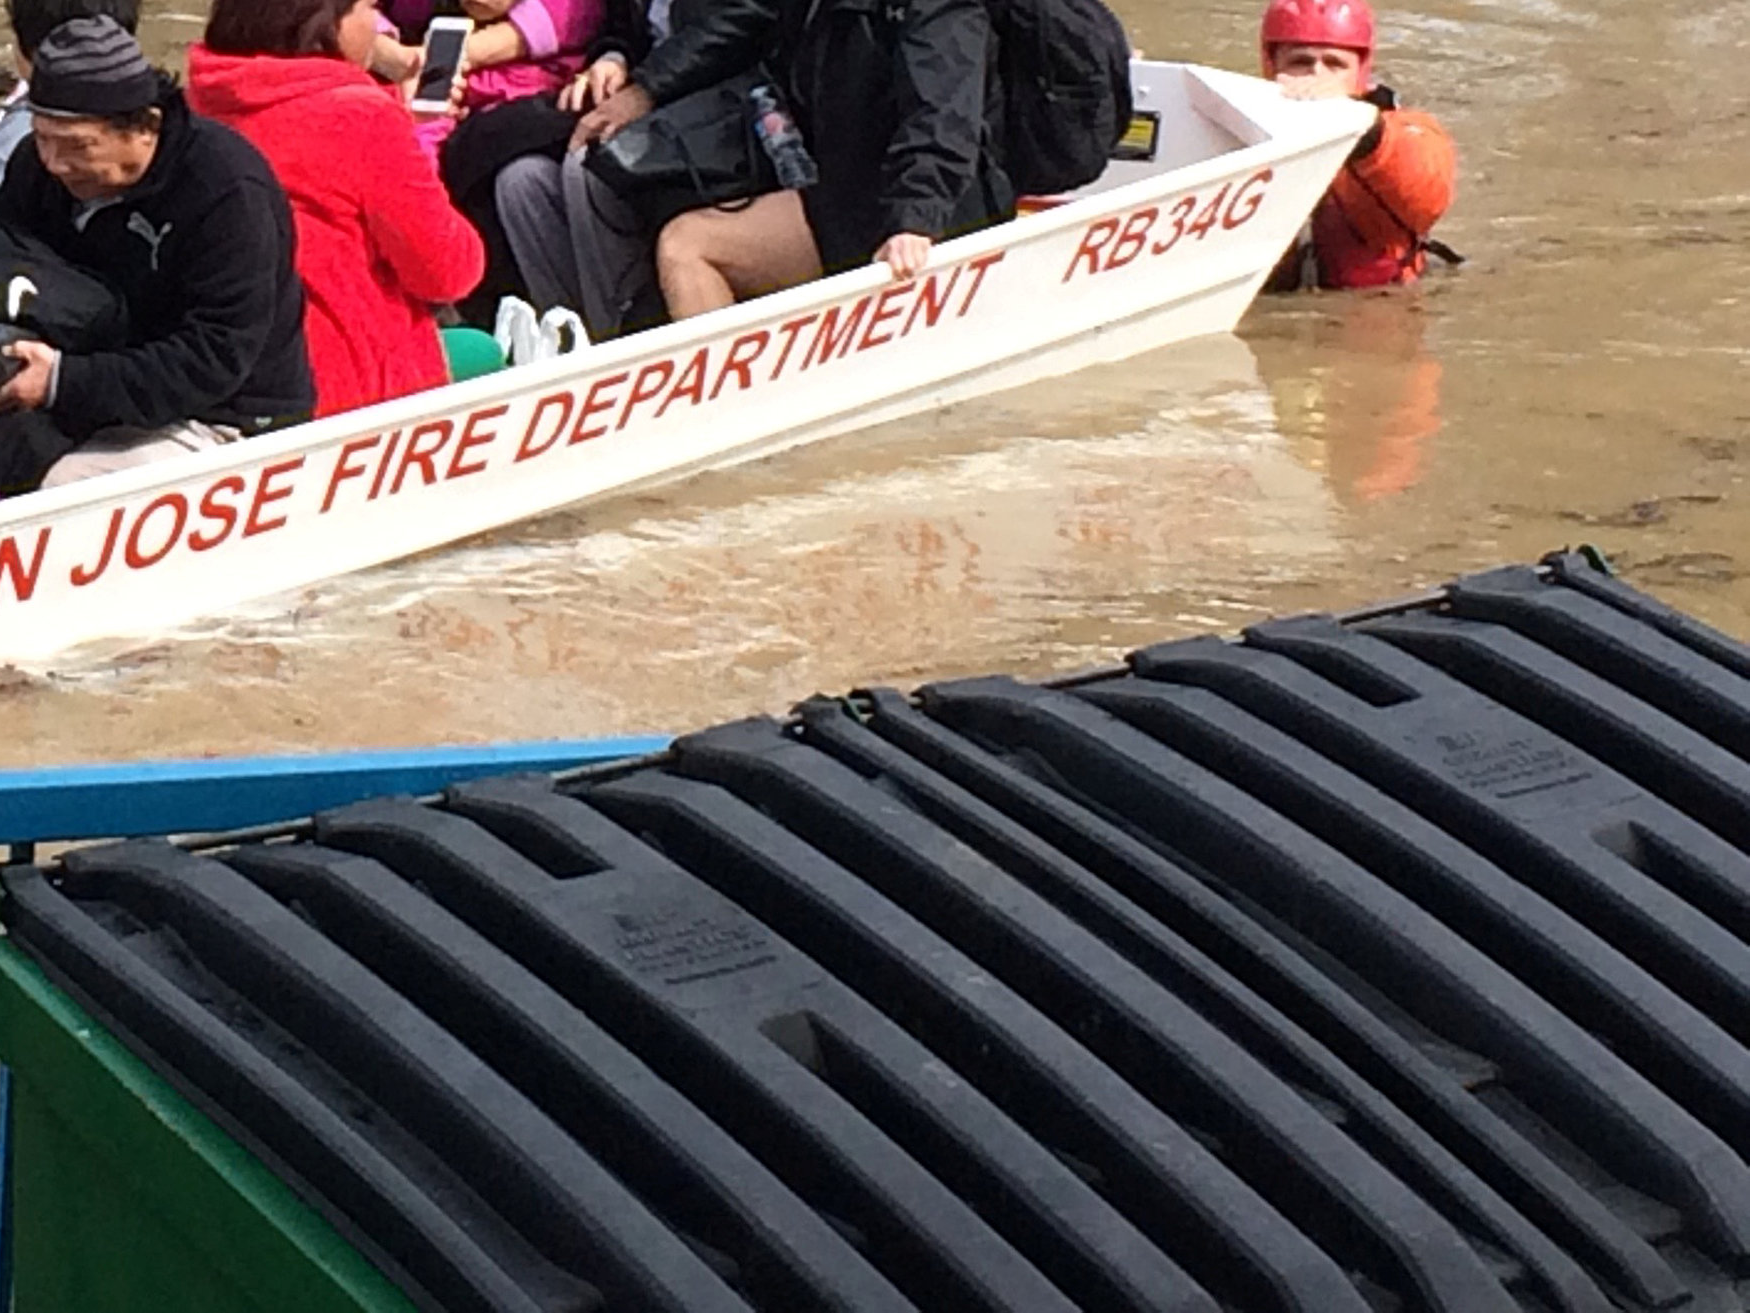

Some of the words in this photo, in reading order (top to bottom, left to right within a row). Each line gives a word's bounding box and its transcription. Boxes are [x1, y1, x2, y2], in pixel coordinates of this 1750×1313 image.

[70, 456, 304, 586] JOSE
[321, 405, 507, 512] FIRE
[514, 252, 1004, 462] DEPARTMENT
[1061, 169, 1273, 283] RB34G
